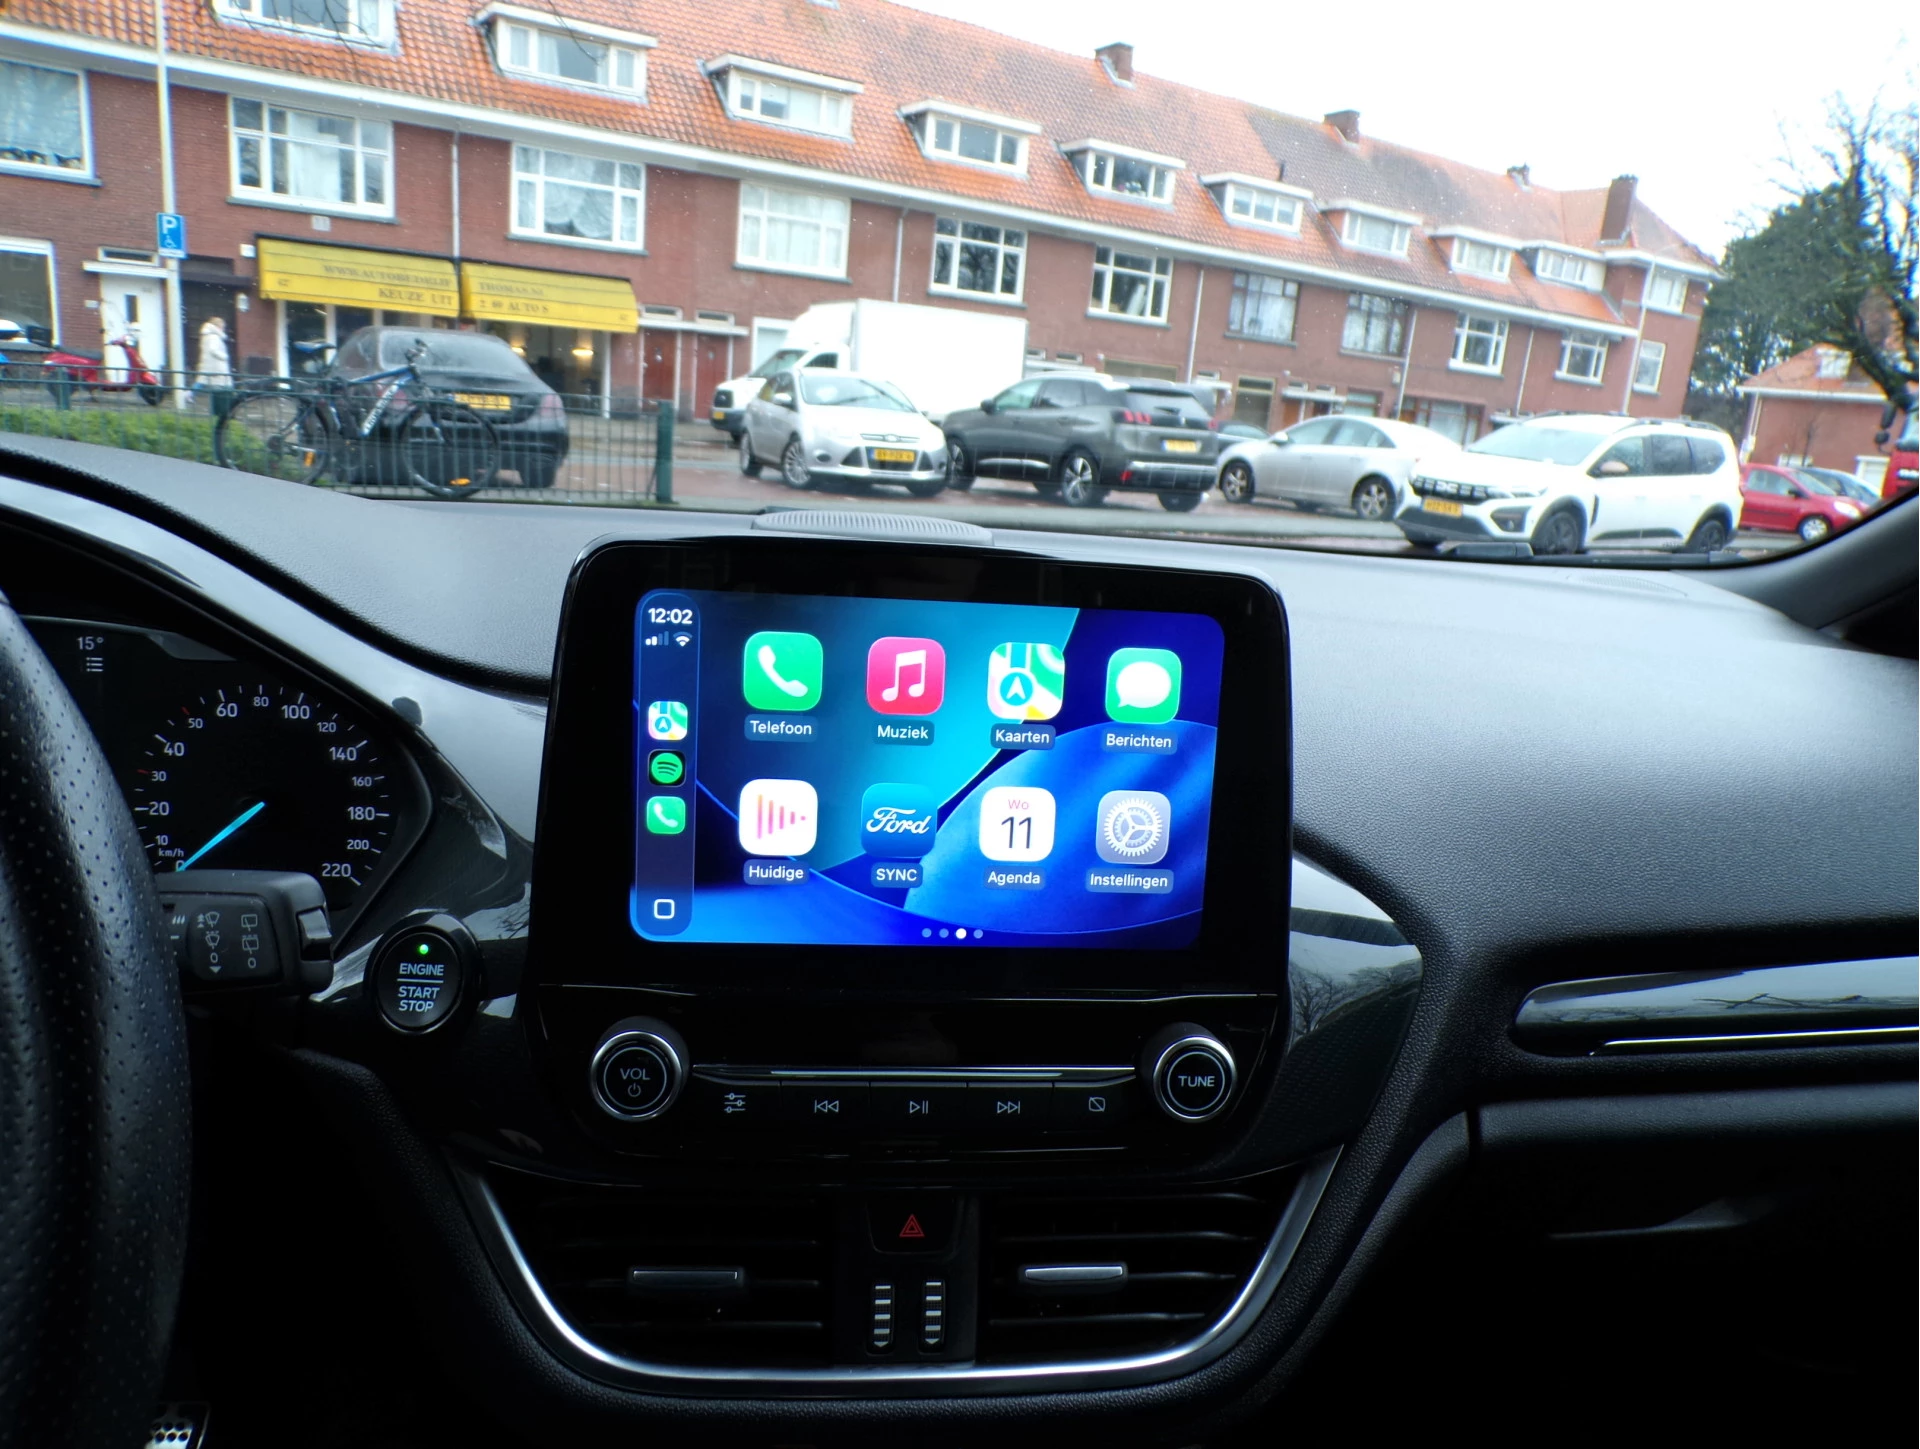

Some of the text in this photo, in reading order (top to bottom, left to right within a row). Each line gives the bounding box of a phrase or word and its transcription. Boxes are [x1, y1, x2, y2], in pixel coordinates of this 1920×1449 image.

[162, 215, 178, 235] P
[378, 288, 453, 307] KEUZE UIT
[648, 607, 693, 625] 12:02
[77, 636, 104, 651] 15°
[253, 696, 269, 707] 80
[216, 703, 238, 718] 60
[281, 704, 310, 720] 100
[188, 718, 204, 729] 50
[316, 721, 337, 733] 120
[750, 720, 812, 735] Telefoon
[877, 724, 929, 739] Muziek
[995, 729, 1050, 744] Kaarten
[1106, 733, 1172, 748] Berichten
[164, 741, 185, 757] 40
[329, 747, 357, 761] 140
[151, 771, 167, 782] 30
[351, 776, 372, 787] 160
[149, 801, 170, 816] 20
[1007, 799, 1030, 810] Wo
[347, 806, 375, 820] 180
[866, 806, 932, 834] Ford
[1001, 816, 1032, 849] 11
[155, 835, 168, 846] 10
[346, 839, 369, 850] 200
[158, 848, 184, 858] km/h
[321, 863, 351, 877] 220
[749, 865, 804, 881] Huidige
[876, 868, 918, 881] SYNC
[987, 871, 1041, 886] Agenda
[1090, 873, 1168, 890] Instellingen
[399, 962, 444, 976] ENGINE
[397, 985, 440, 999] START
[398, 999, 434, 1012] STOP
[620, 1068, 651, 1081] VOL
[1178, 1075, 1215, 1087] TUNE
